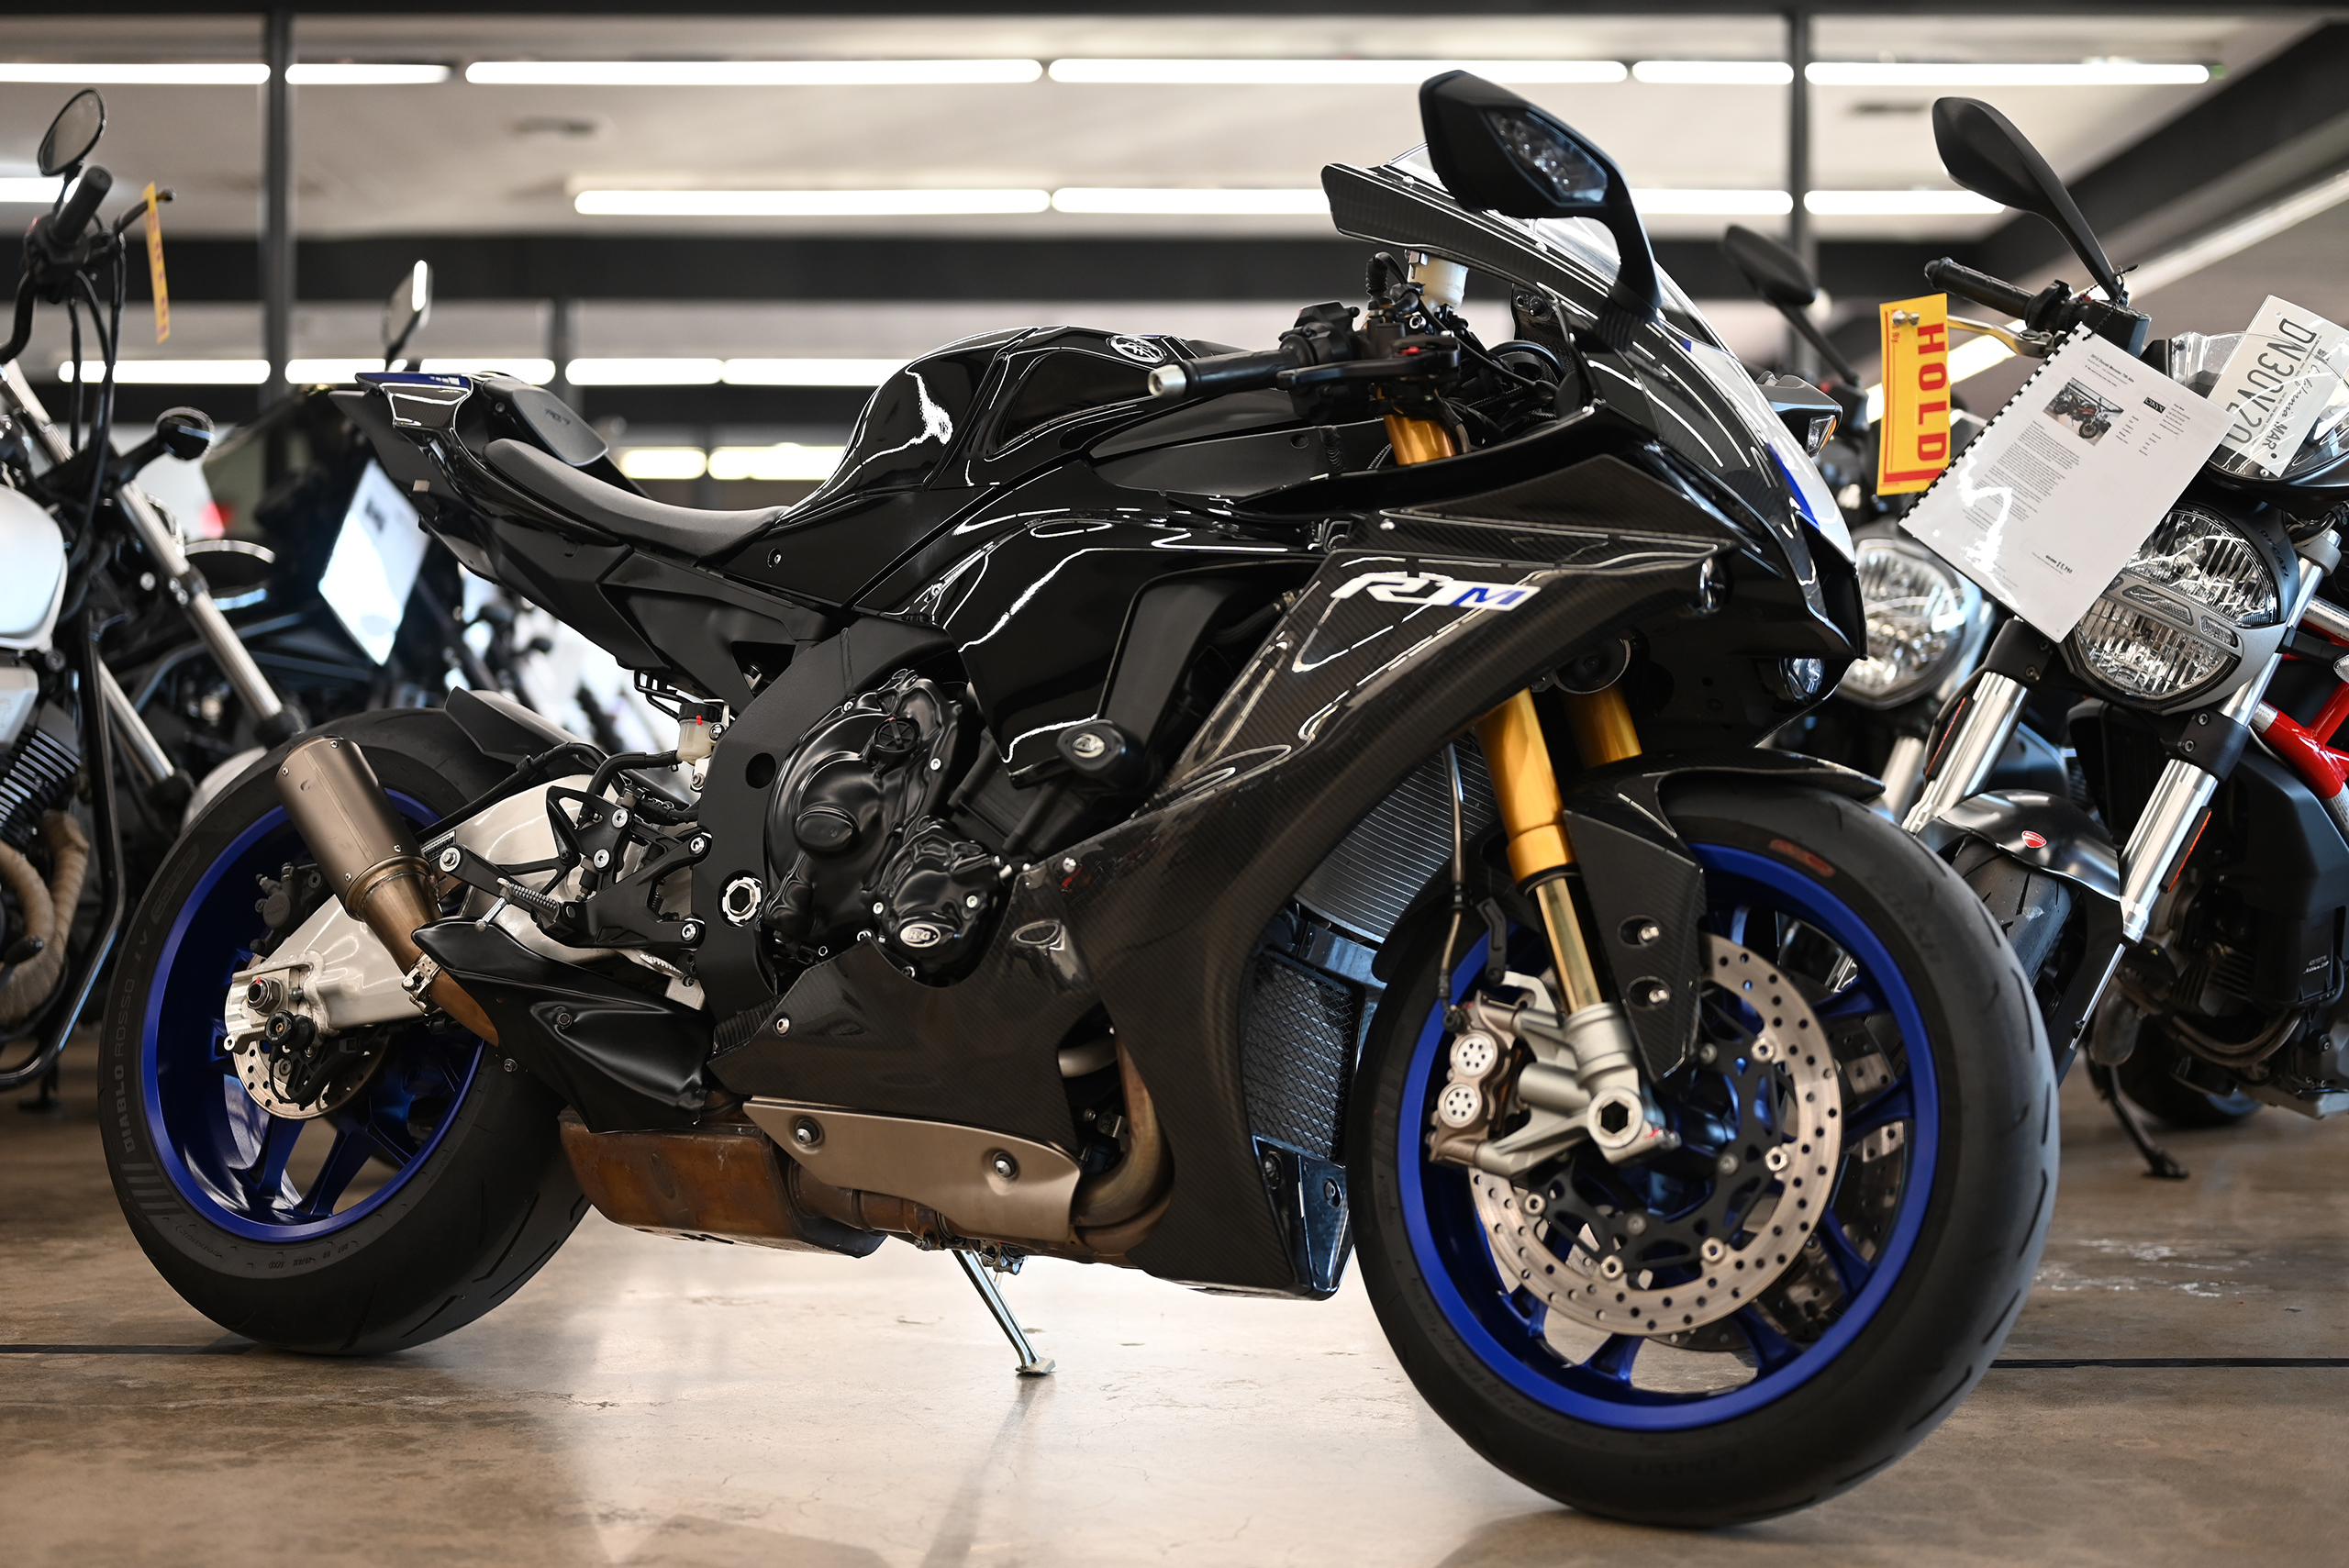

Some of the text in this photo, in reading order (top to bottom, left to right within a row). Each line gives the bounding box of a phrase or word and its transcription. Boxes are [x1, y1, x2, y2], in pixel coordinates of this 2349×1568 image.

[1917, 322, 1947, 461] HOLD
[2263, 421, 2288, 450] MAR
[2259, 528, 2290, 577] DUCATI
[2025, 831, 2044, 842] DUCATI
[132, 928, 148, 962] IV
[112, 976, 136, 1056] ROSSO
[114, 1064, 137, 1152] DIABLO
